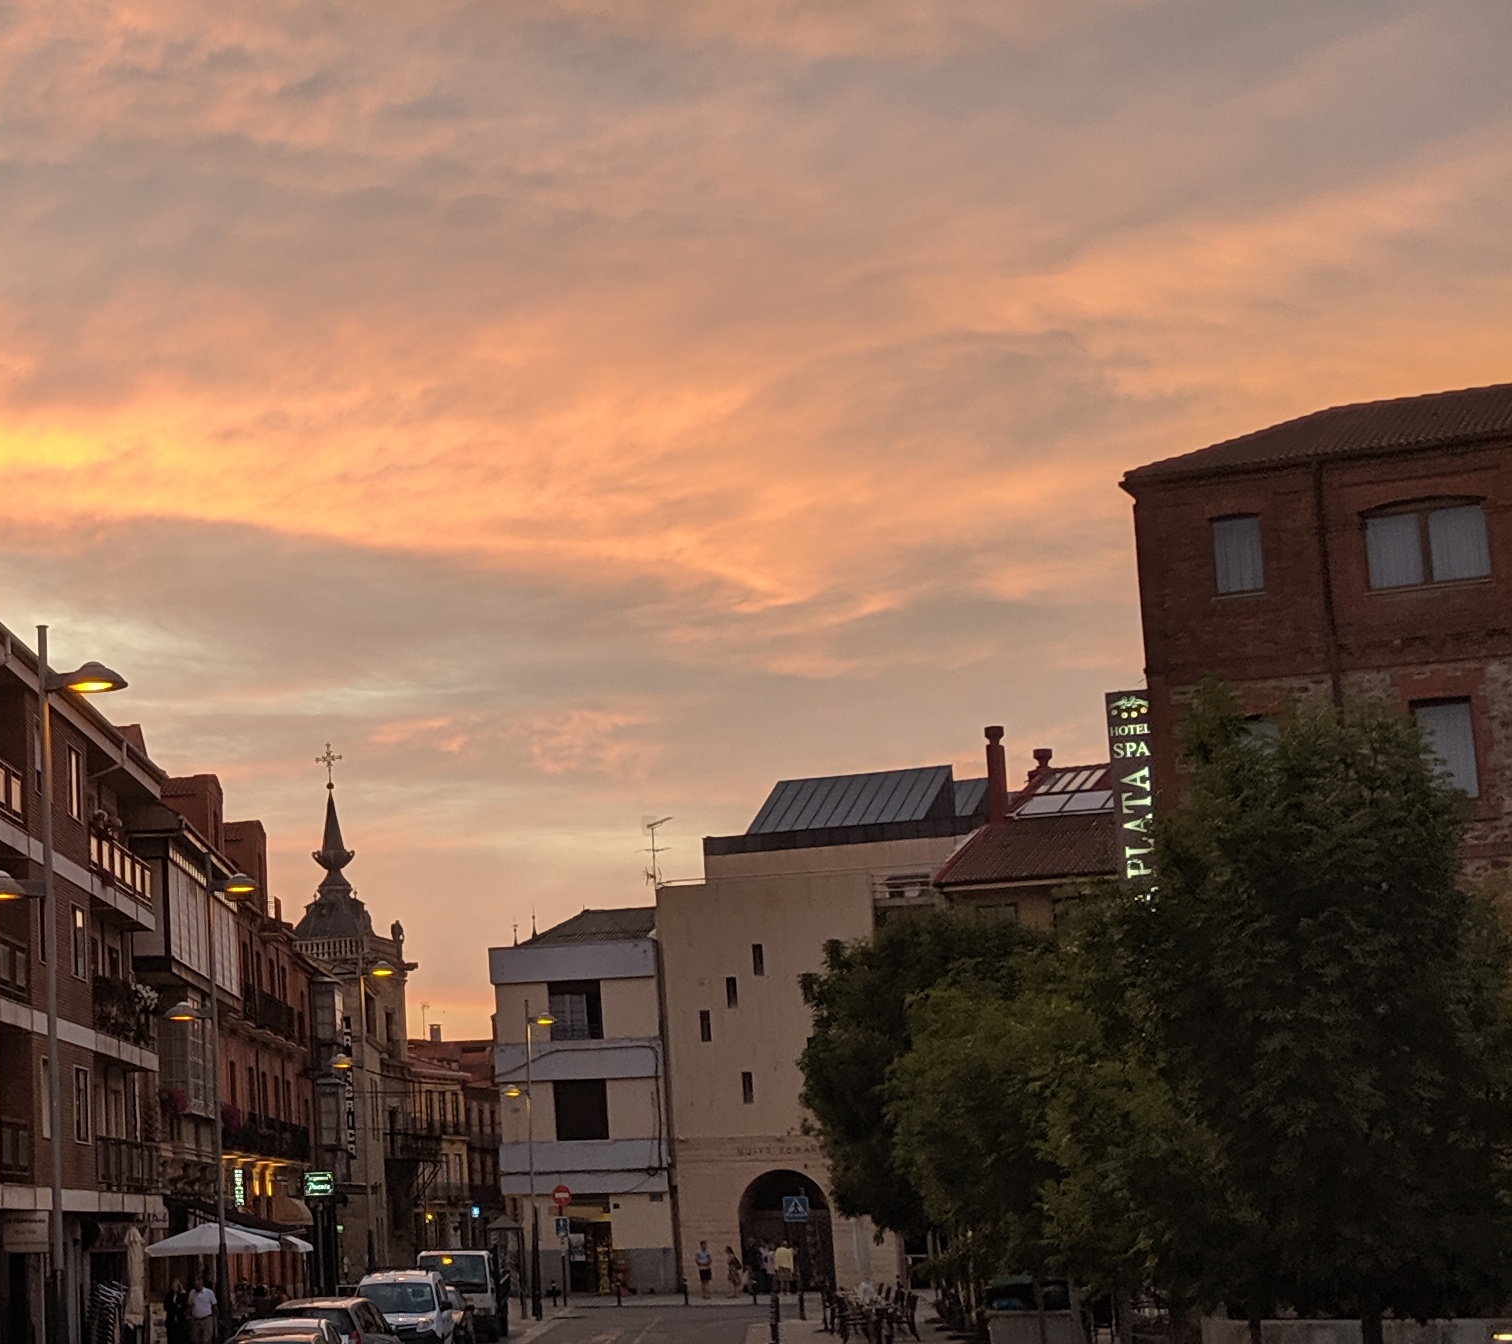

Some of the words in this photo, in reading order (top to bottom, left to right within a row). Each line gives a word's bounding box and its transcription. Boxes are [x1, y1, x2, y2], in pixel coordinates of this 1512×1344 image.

[1110, 724, 1150, 736] HOTEL
[1113, 741, 1151, 759] SPA
[1120, 766, 1155, 879] PLATA
[345, 1058, 356, 1156] ABRICA
